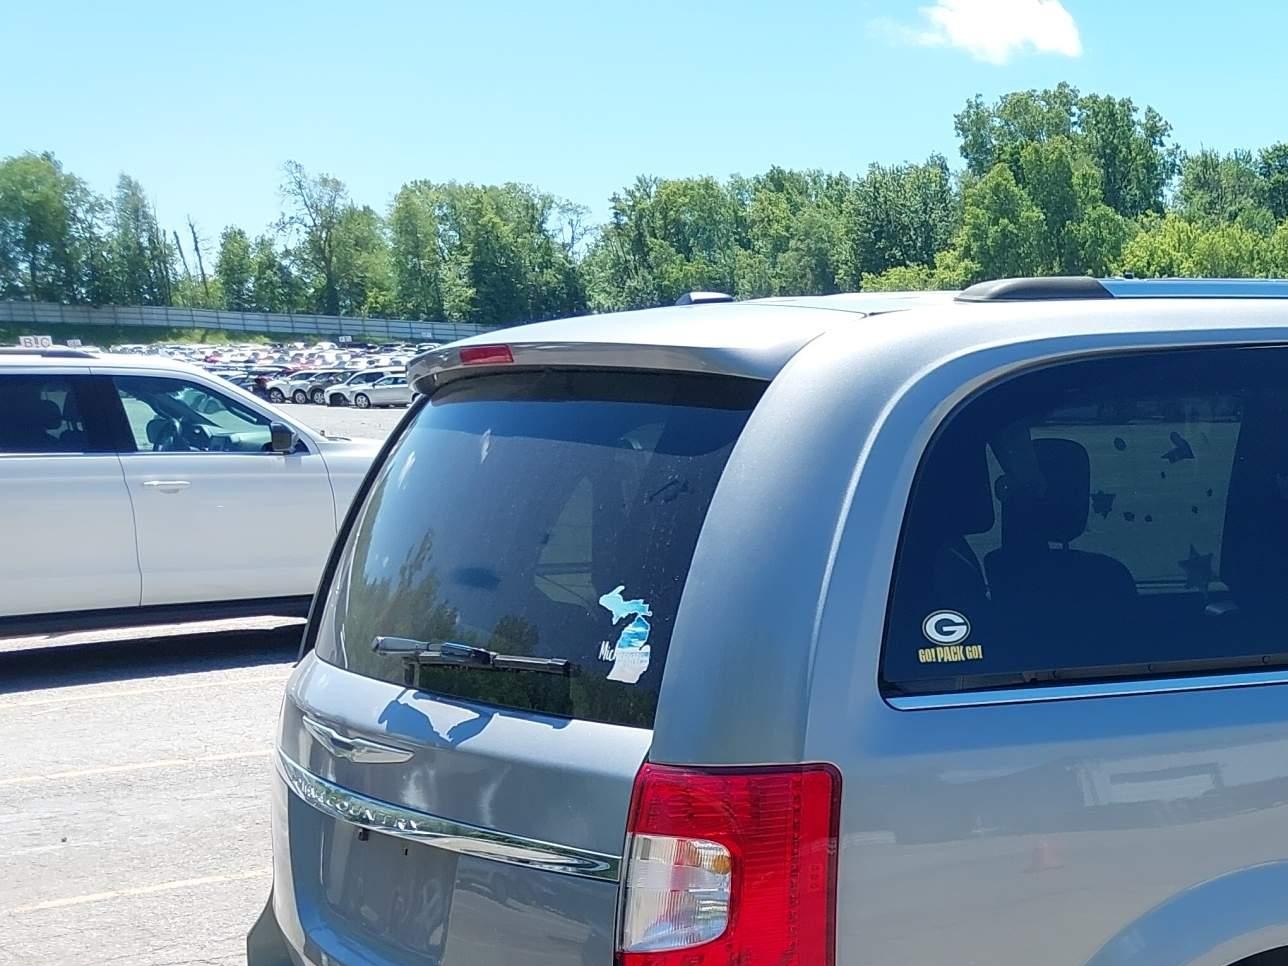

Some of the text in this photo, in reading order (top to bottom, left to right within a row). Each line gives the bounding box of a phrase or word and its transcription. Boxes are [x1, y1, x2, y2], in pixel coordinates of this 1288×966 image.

[924, 611, 969, 644] G
[918, 648, 936, 662] GO!
[937, 646, 966, 662] PACK
